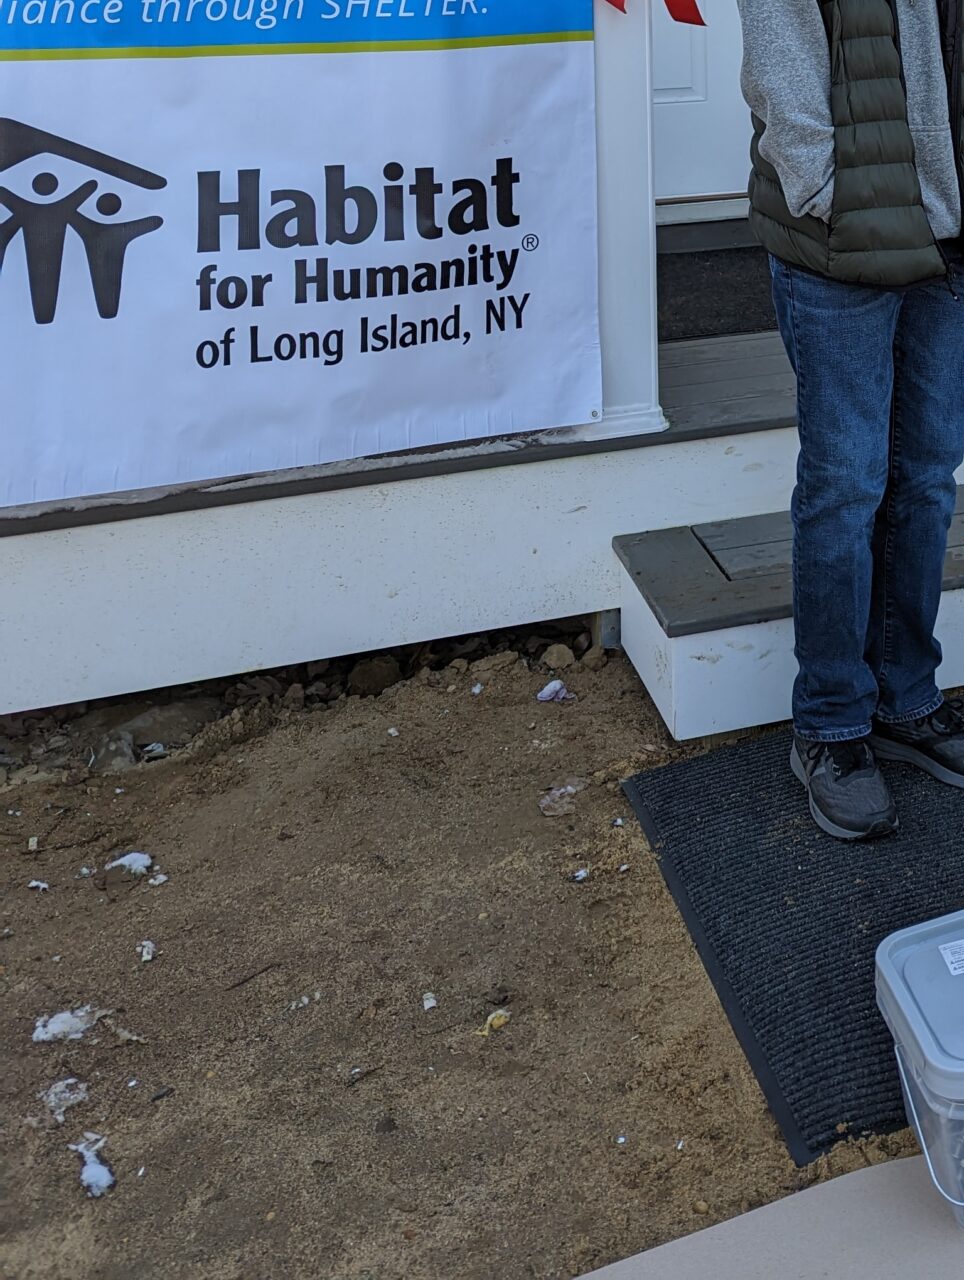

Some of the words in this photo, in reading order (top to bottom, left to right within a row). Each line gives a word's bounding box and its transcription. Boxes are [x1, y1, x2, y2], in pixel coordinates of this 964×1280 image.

[197, 157, 520, 253] Habitat
[196, 264, 272, 311] for
[196, 327, 235, 369] of
[250, 325, 344, 366] Long
[360, 304, 471, 354] Island,
[485, 293, 531, 335] NY
